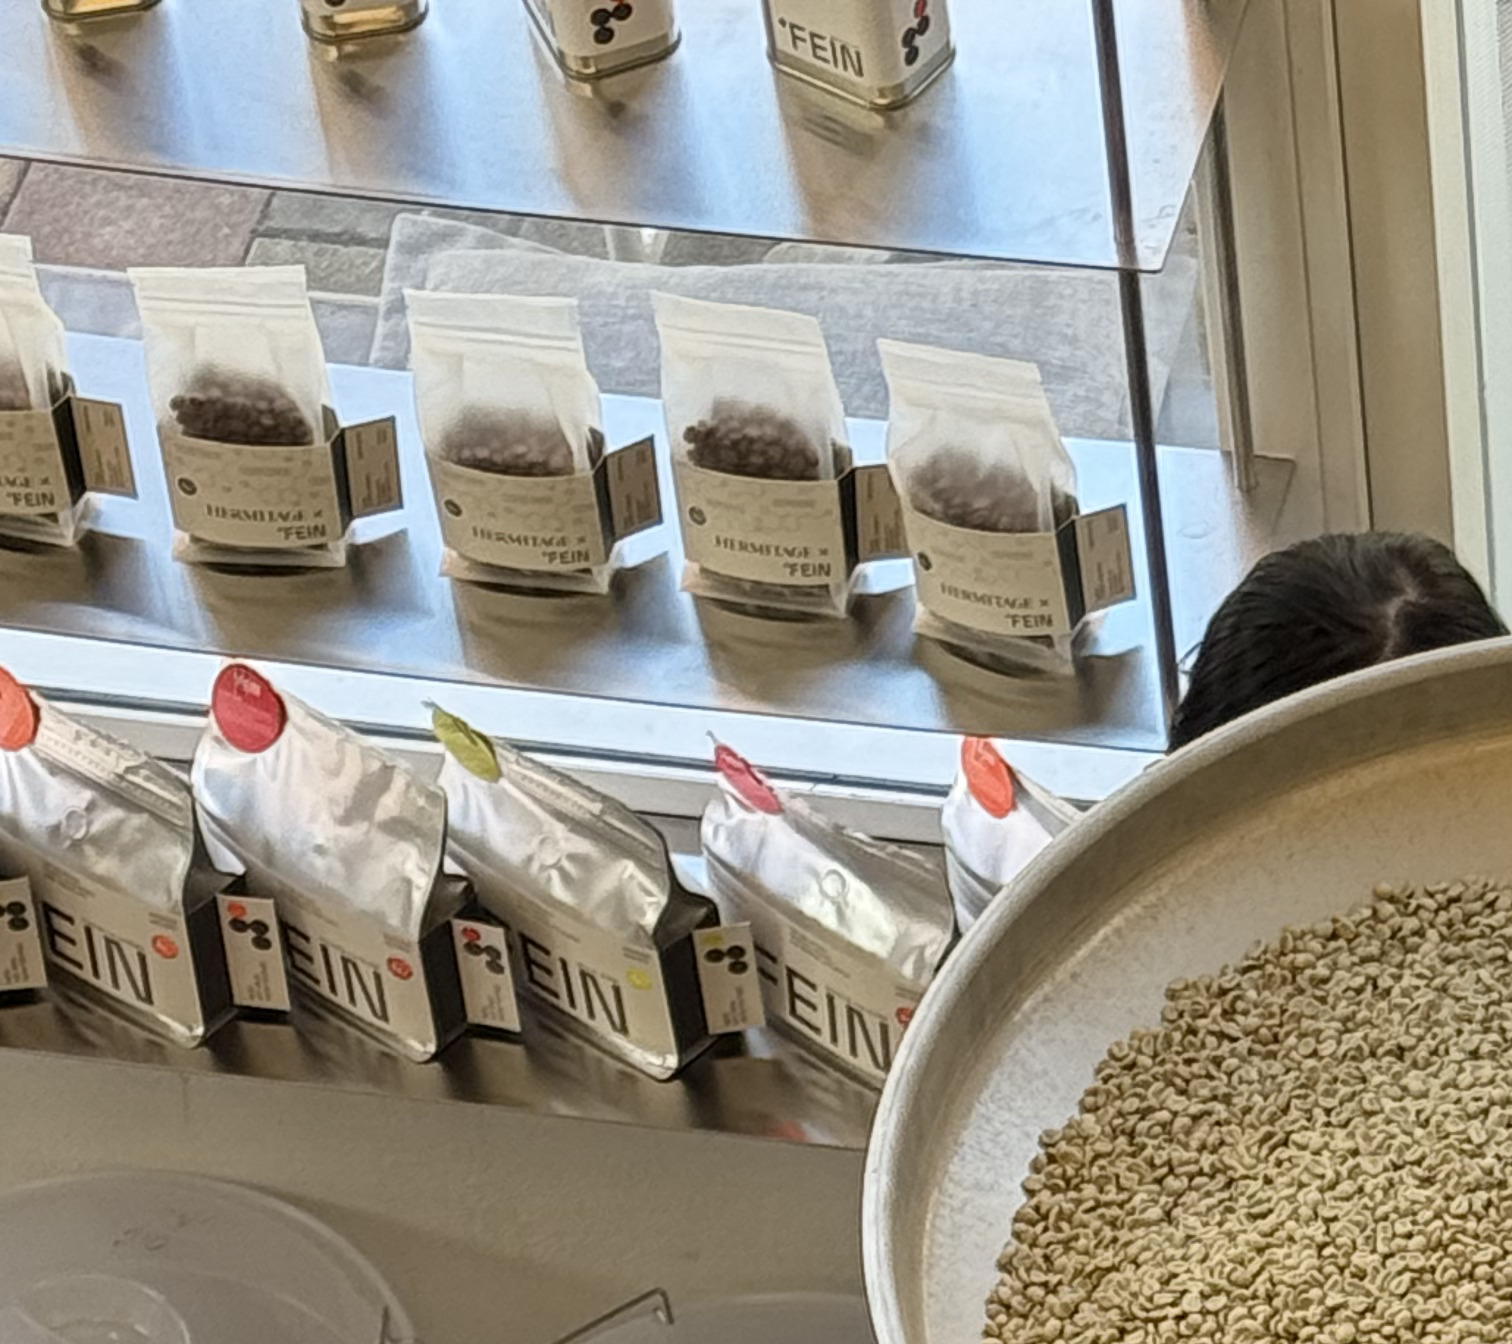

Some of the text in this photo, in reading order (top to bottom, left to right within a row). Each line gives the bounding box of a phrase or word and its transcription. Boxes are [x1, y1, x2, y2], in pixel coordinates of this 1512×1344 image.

[786, 21, 864, 78] FEIN
[41, 901, 154, 1006] EIN
[281, 922, 390, 1024] EIN
[518, 932, 630, 1037] EIN
